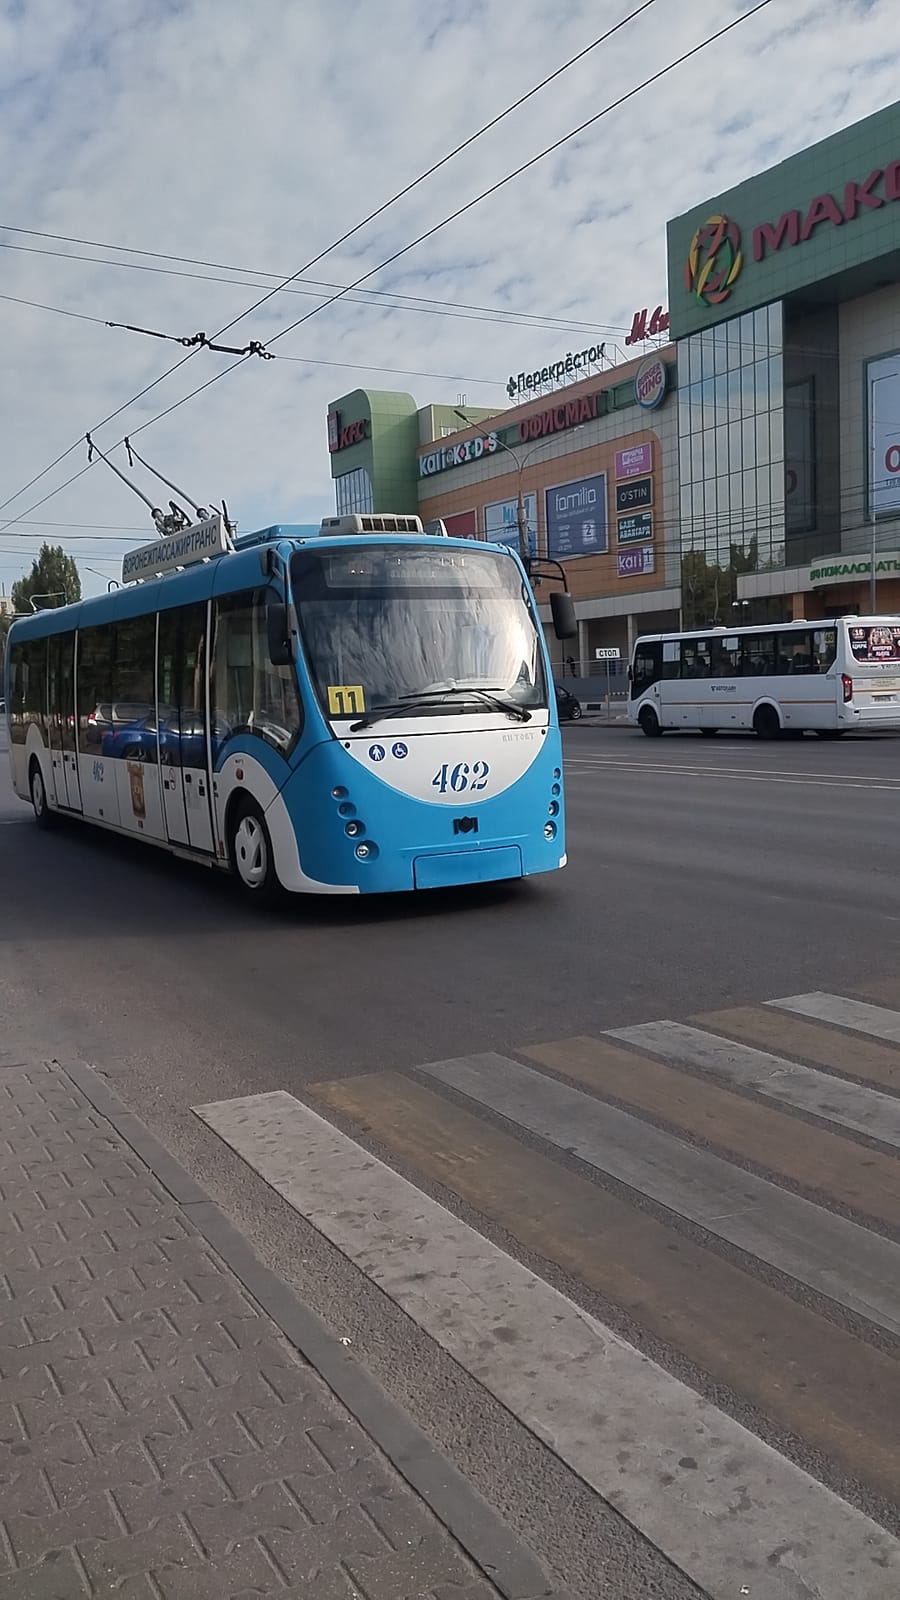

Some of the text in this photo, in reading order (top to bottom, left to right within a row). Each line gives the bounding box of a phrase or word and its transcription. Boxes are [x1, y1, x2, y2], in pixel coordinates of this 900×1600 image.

[517, 341, 606, 392] Перекрёсток
[639, 371, 662, 400] KING
[518, 391, 602, 443] ОФИСМАГ
[338, 419, 366, 449] KFC
[555, 486, 597, 512] familia
[620, 487, 648, 502] O'STIN
[123, 525, 217, 576] ВОРОНЕЖПАССАЖИРТРАНС
[598, 649, 617, 657] СТОП
[335, 691, 358, 713] 11
[432, 760, 490, 794] 462
